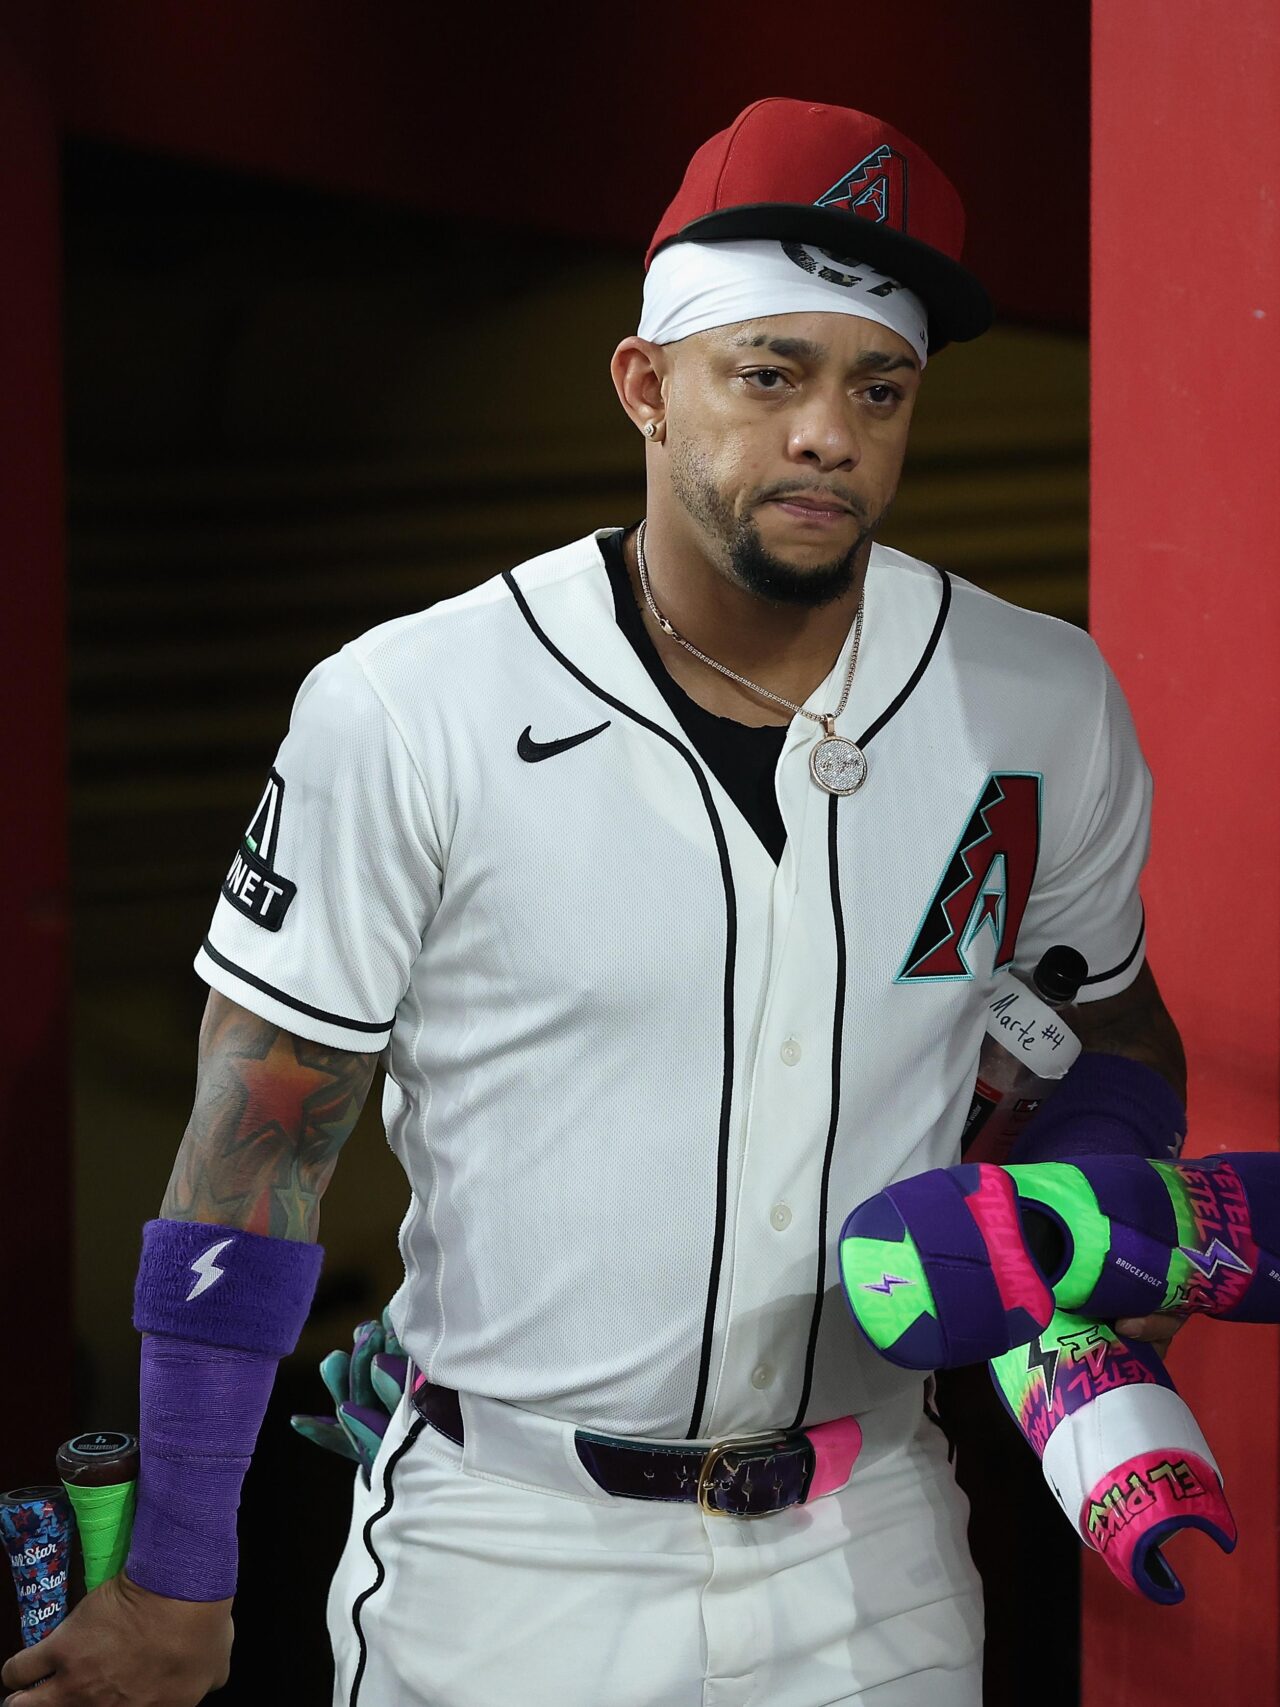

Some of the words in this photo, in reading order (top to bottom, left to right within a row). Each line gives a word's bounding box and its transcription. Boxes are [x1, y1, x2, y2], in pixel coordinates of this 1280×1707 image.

[227, 849, 284, 916] NET
[989, 993, 1036, 1051] Marte
[1041, 1024, 1065, 1051] #4
